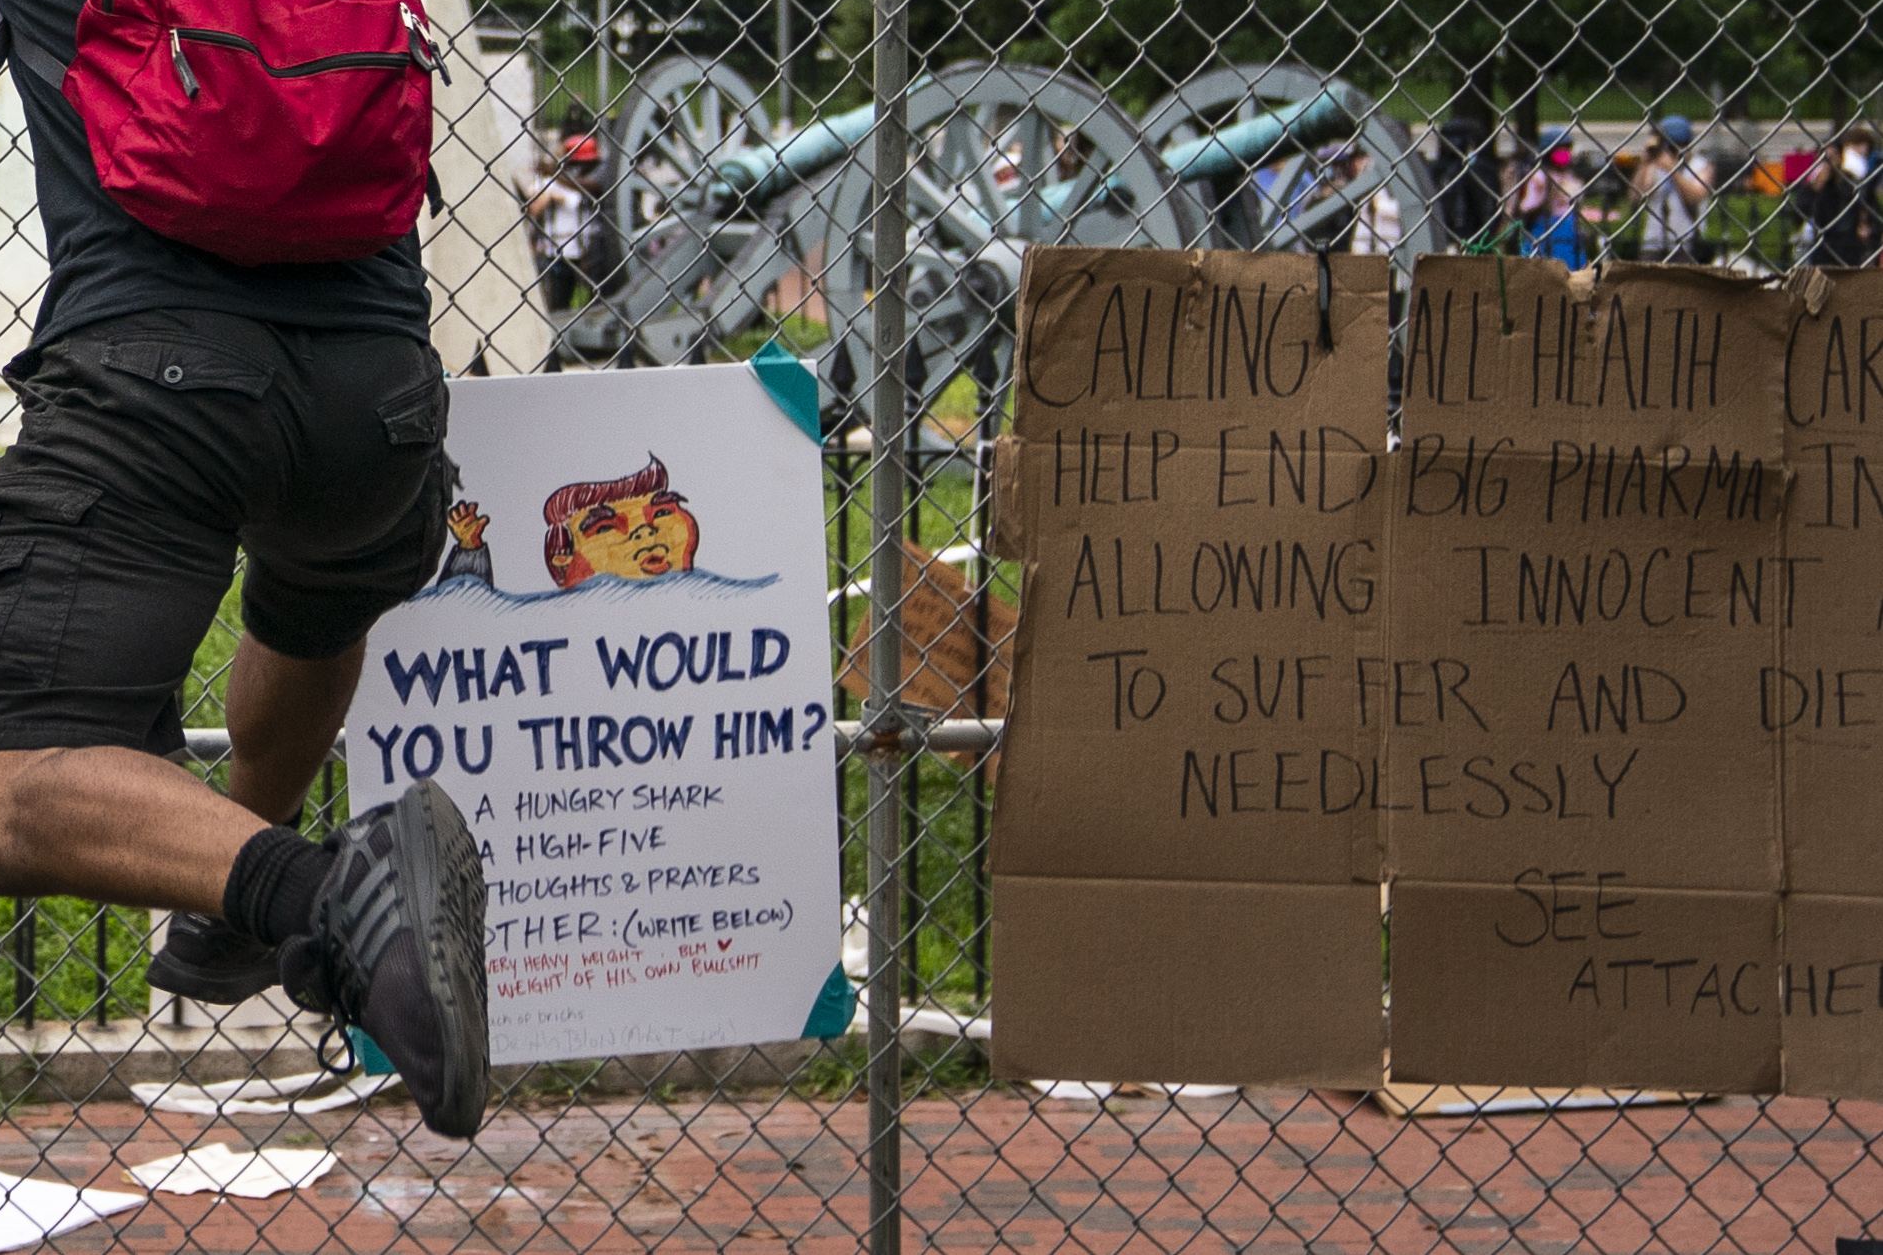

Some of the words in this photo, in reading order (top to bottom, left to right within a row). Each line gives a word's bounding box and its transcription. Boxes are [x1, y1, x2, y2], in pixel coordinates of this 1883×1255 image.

[1024, 269, 1309, 408] CALLING
[1407, 288, 1489, 404] ALL
[1532, 294, 1721, 410] HEALTH
[1055, 427, 1180, 507] HELP
[1219, 425, 1377, 513] END
[1407, 434, 1514, 518] BIG
[1547, 440, 1763, 523] PHARMA
[1067, 534, 1374, 620] ALLOWING
[1453, 547, 1823, 628] INNOCENT
[383, 638, 568, 707] WHAT
[596, 628, 791, 691] WOULD
[1088, 649, 1167, 730] TO
[1548, 661, 1687, 734] AND
[1760, 667, 1883, 731] DIE
[367, 723, 493, 785] YOU
[518, 714, 694, 772] THROW
[714, 702, 827, 760] HIM?
[475, 793, 495, 824] A
[514, 788, 625, 822] HUNGRY
[633, 784, 723, 810] SHARK
[480, 839, 495, 866] A
[484, 873, 613, 905] THOUGHTS
[621, 873, 640, 894] &
[648, 864, 760, 894] PRAYERS
[622, 909, 704, 948] (WRITE
[712, 899, 793, 931] BELOW)
[1495, 868, 1642, 947] SEE
[497, 972, 563, 999] WEIGHT
[573, 968, 595, 989] OF
[607, 968, 637, 989] HIS
[645, 961, 681, 980] OWN
[523, 952, 568, 979] HEAVY
[582, 949, 644, 967] WEIGHT
[679, 943, 707, 960] BLM
[1569, 958, 1883, 1018] ATTACHE
